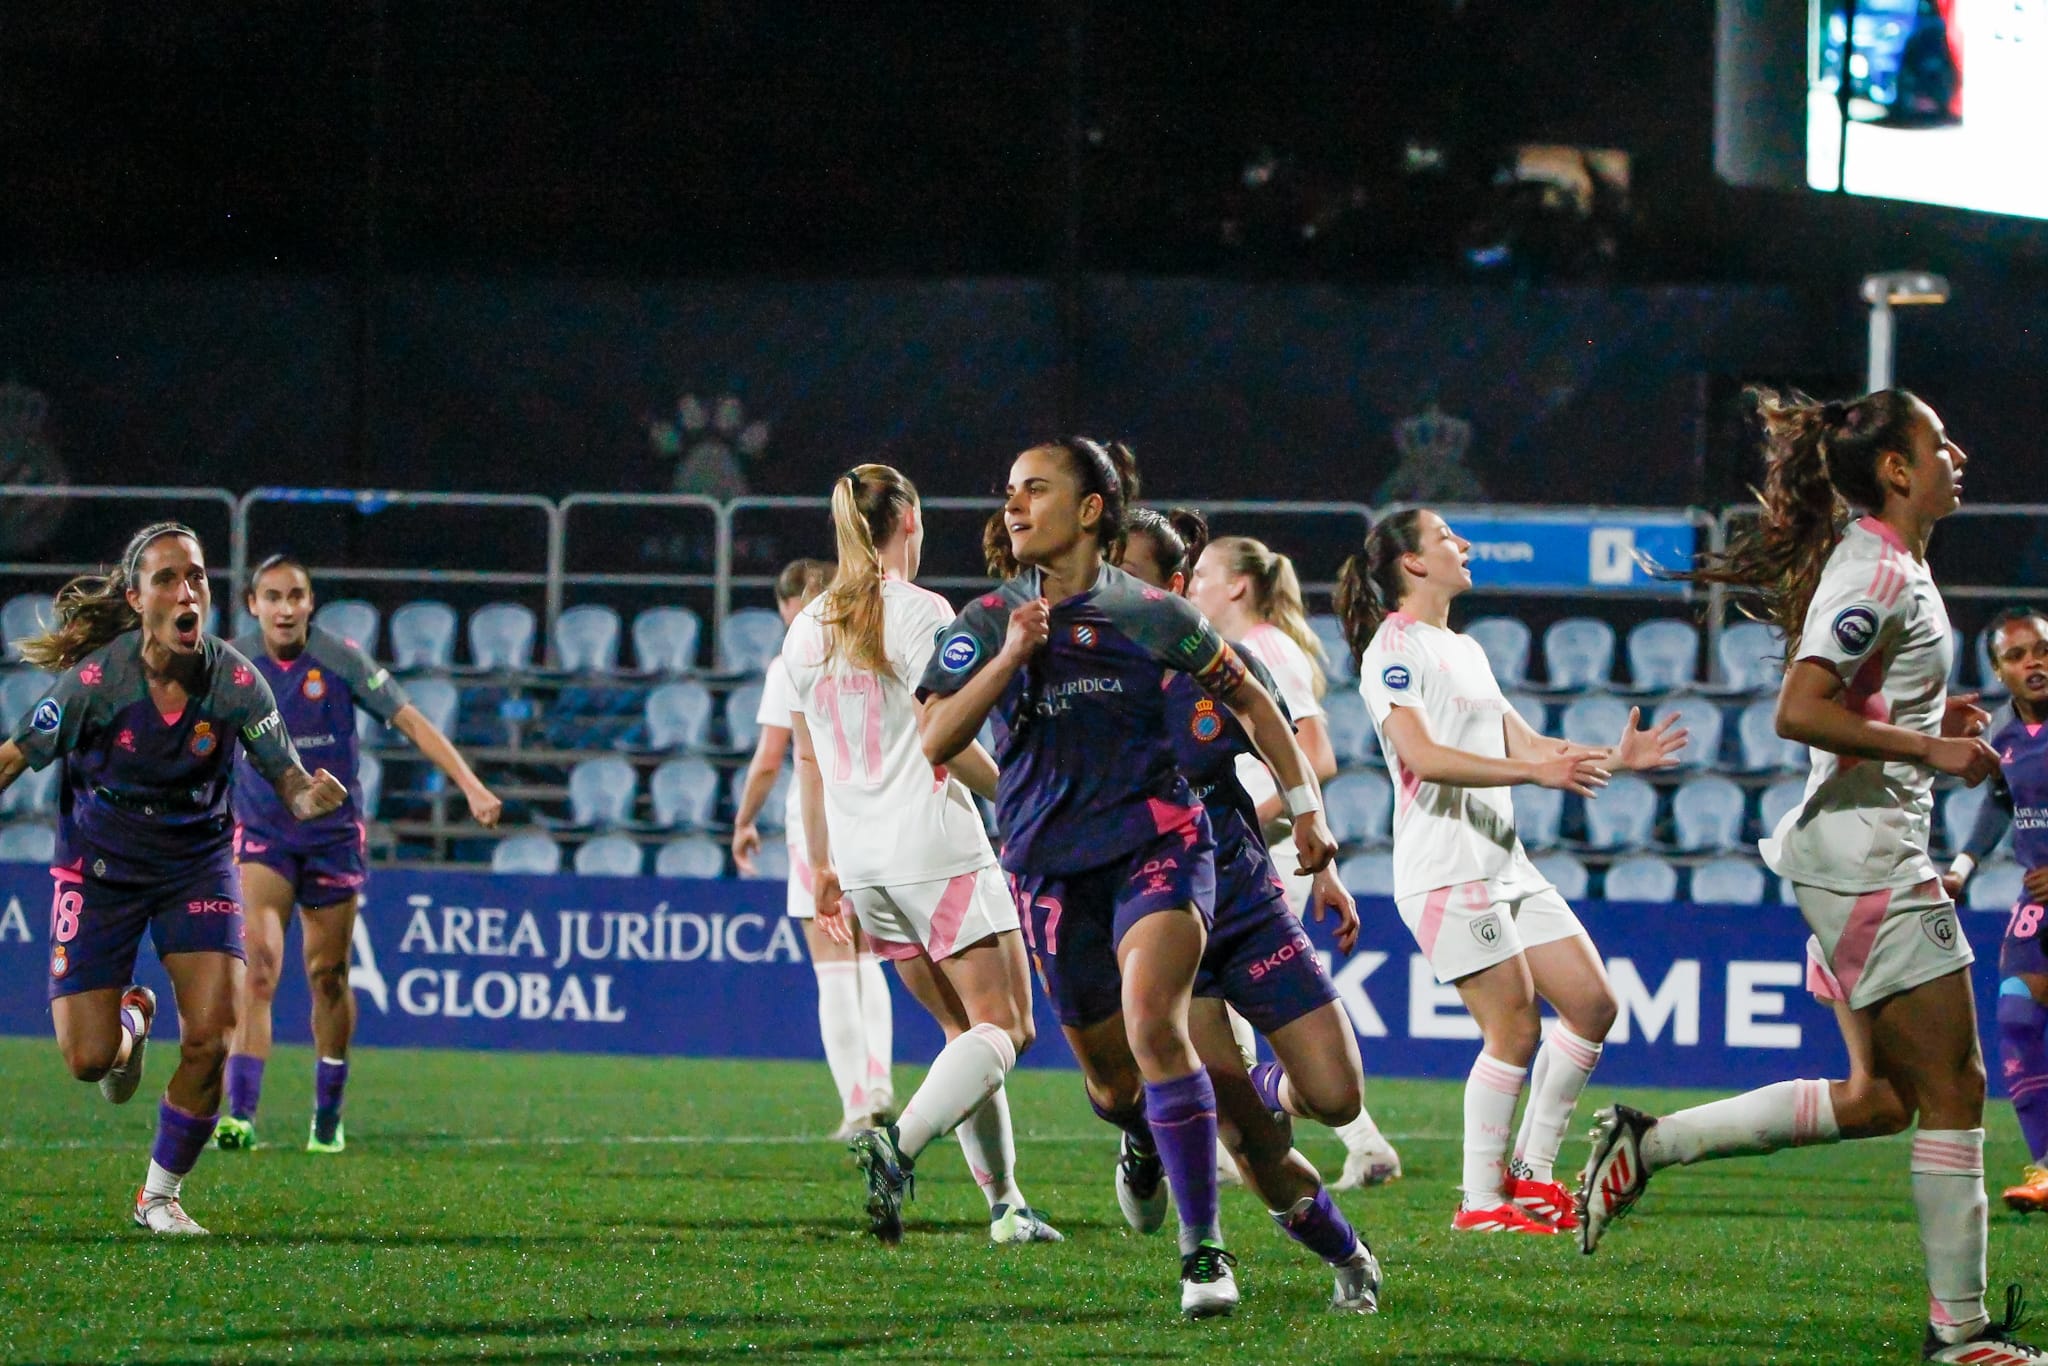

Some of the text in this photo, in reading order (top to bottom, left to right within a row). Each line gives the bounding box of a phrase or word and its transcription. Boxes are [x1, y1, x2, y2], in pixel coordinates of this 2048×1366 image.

[815, 673, 882, 786] 17
[553, 900, 802, 968] JURÍDICA
[1020, 890, 1063, 956] 17
[397, 968, 627, 1023] GLOBAL
[1318, 950, 1802, 1049] KEME
